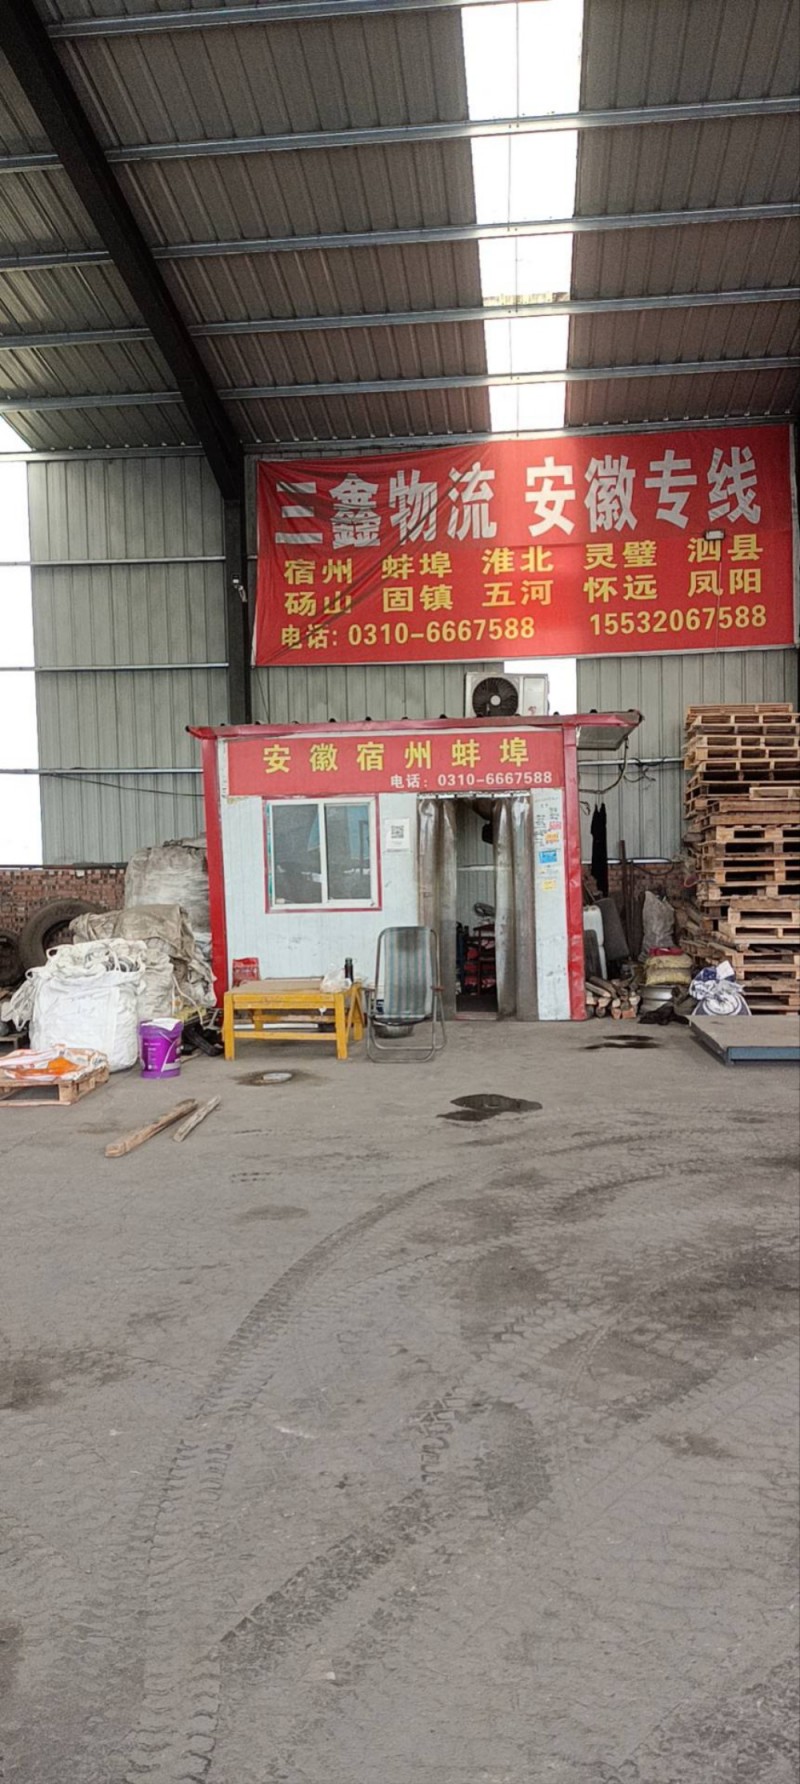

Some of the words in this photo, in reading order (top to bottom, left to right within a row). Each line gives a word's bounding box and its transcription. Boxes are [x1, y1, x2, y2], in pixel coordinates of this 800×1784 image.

[274, 461, 498, 550] 三鑫物流
[524, 445, 762, 537] 安徽专线
[284, 557, 353, 585] 宿州
[381, 551, 453, 579] 蚌埠
[482, 545, 554, 575] 淮北
[585, 539, 658, 569] 灵璧
[688, 534, 763, 563] 泗县
[284, 589, 352, 616] 砀山
[383, 585, 453, 613] 固镇
[482, 579, 554, 607] 五河
[584, 574, 657, 603] 怀远
[688, 568, 762, 597] 凤阳
[348, 617, 535, 646] 0310-6667588
[590, 605, 767, 635] 15532067588
[262, 736, 530, 774] 安徽宿州蚌埠
[438, 771, 553, 787] 0310-6667588
